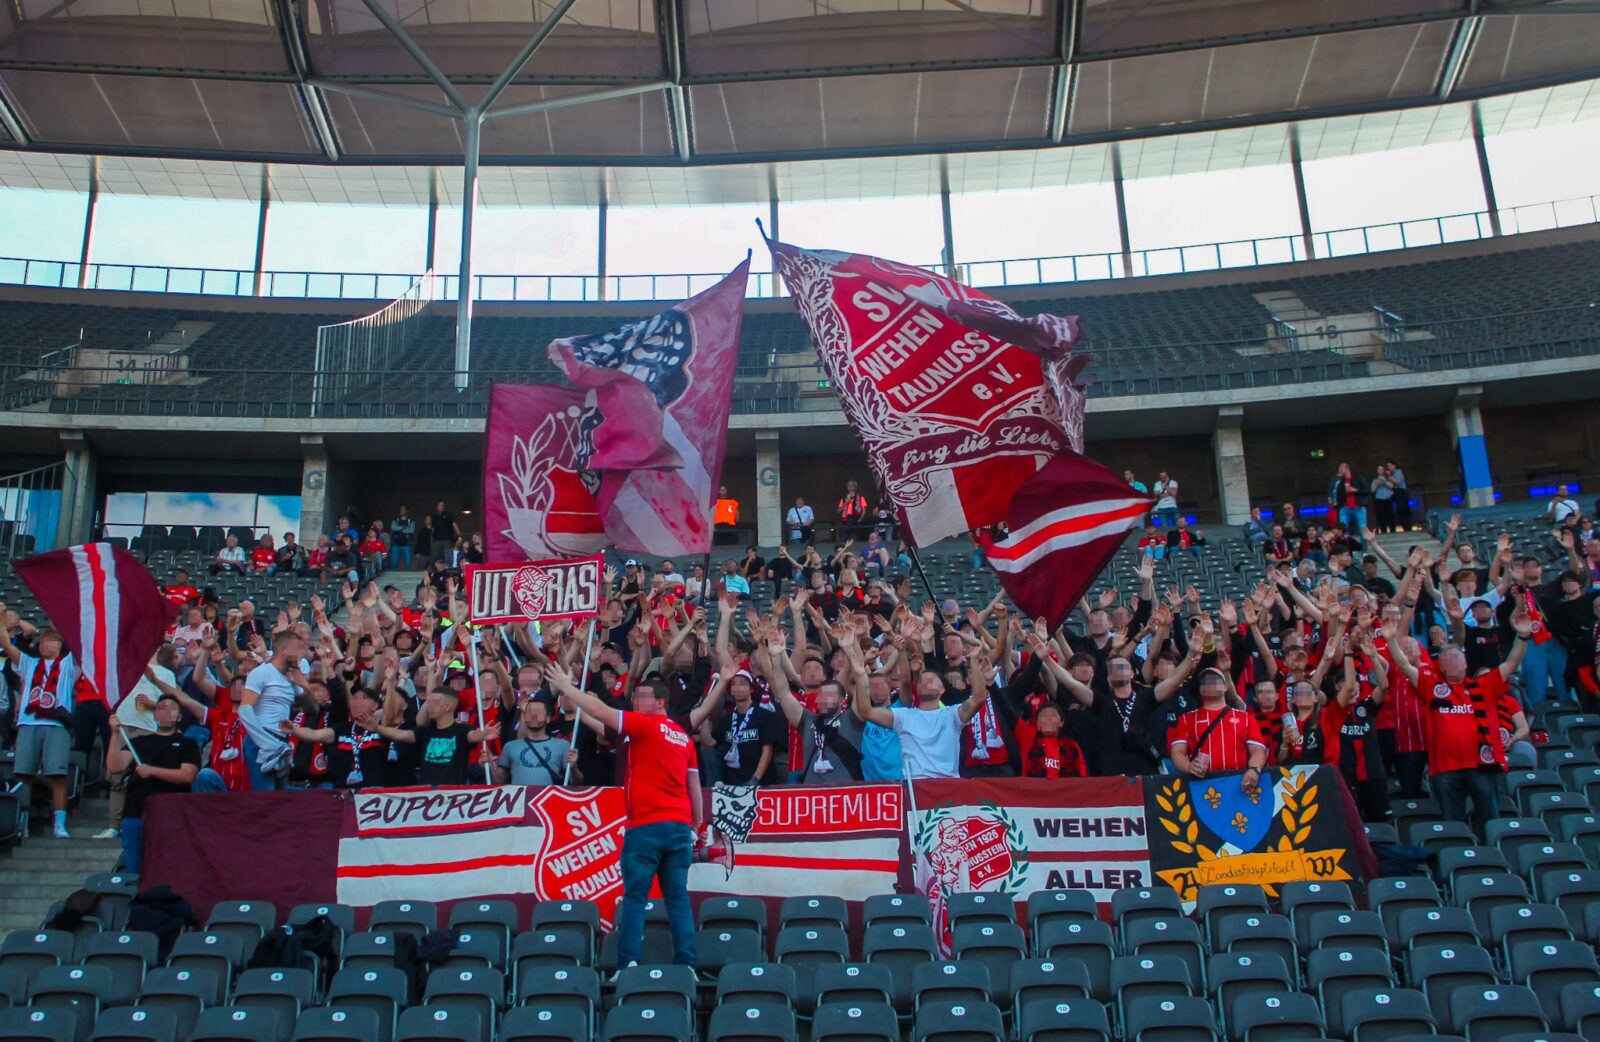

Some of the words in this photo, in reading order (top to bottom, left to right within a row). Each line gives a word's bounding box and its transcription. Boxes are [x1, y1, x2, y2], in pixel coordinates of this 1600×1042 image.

[1315, 325, 1338, 340] 16
[858, 308, 944, 382] WEHEN
[116, 359, 137, 373] 14
[954, 433, 991, 456] die
[305, 470, 324, 490] G
[759, 465, 779, 486] G
[358, 786, 525, 825] SUPCREW
[758, 791, 898, 826] SUPREMUS
[566, 800, 602, 837] SV
[1033, 816, 1146, 838] WEHEN
[977, 829, 999, 846] 1926
[546, 833, 618, 878] WEHEN
[1045, 868, 1143, 890] ALLER
